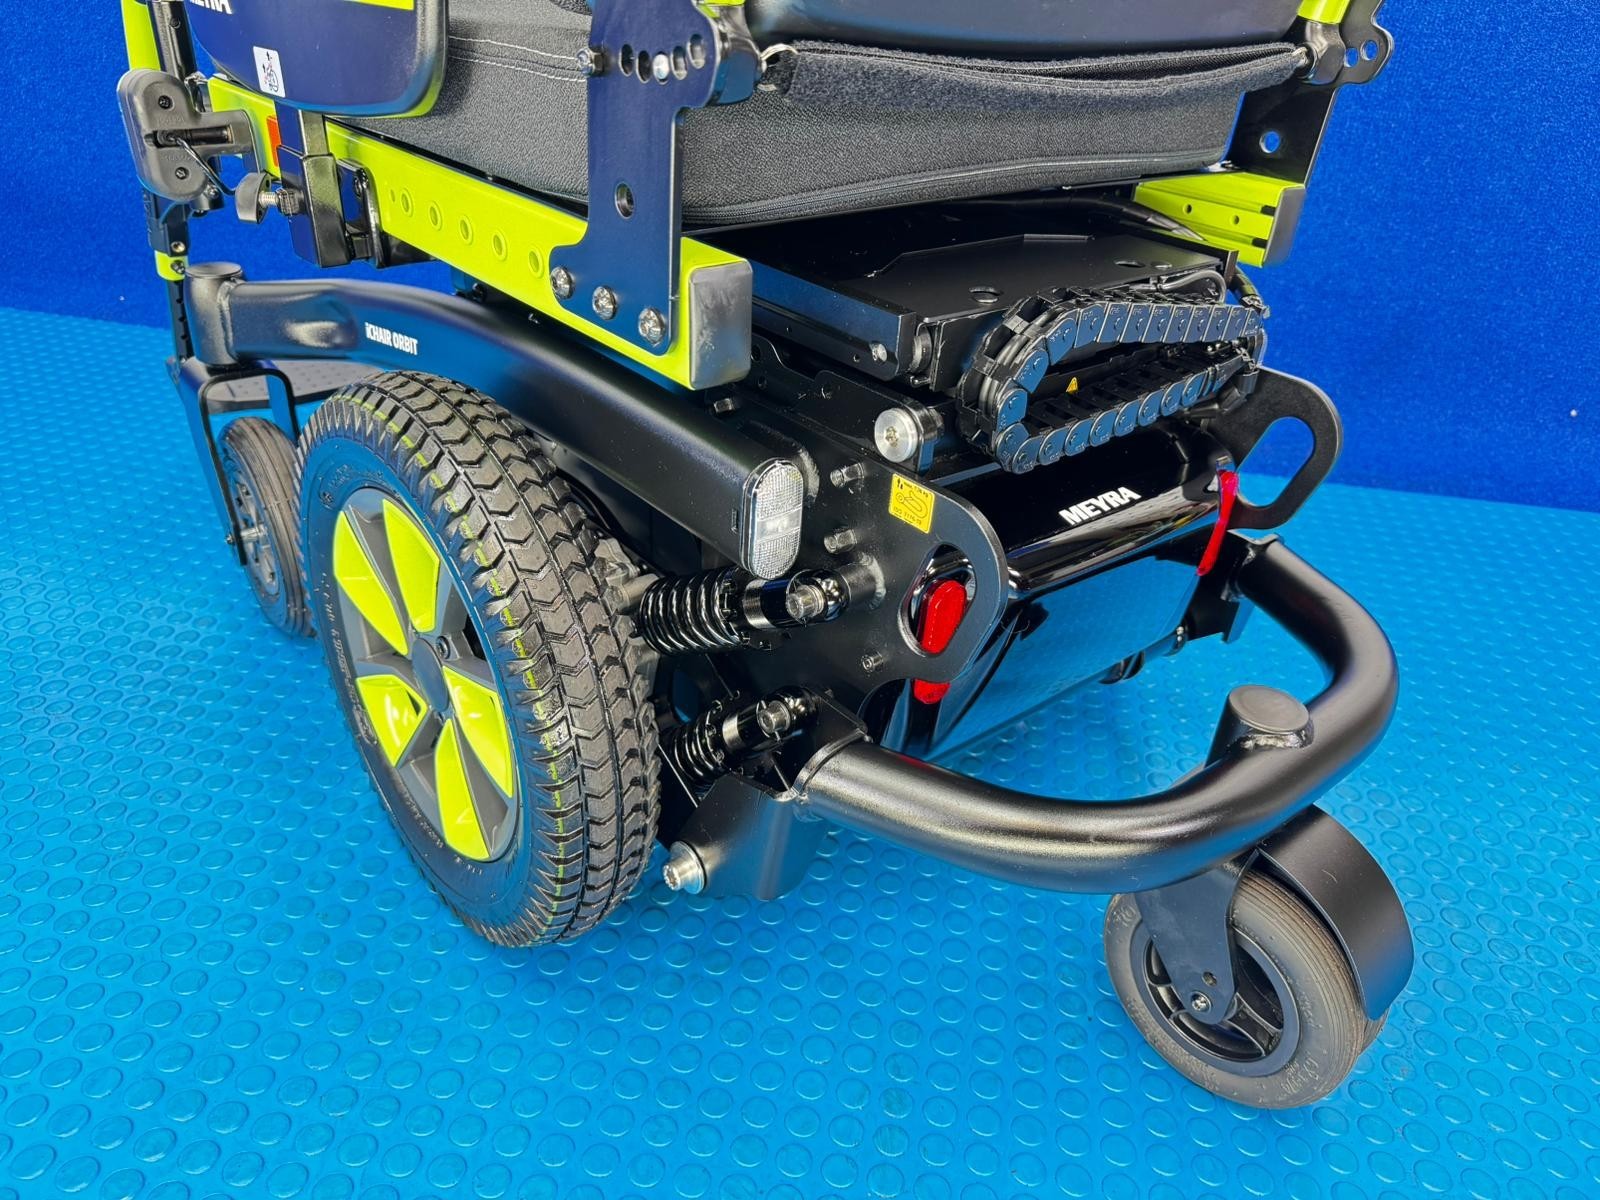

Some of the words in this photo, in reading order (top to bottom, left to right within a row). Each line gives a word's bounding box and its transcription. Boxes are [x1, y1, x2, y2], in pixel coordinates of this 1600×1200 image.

[364, 321, 393, 347] iCHAIR
[392, 331, 418, 356] ORBIT
[1058, 486, 1142, 526] MEYRA
